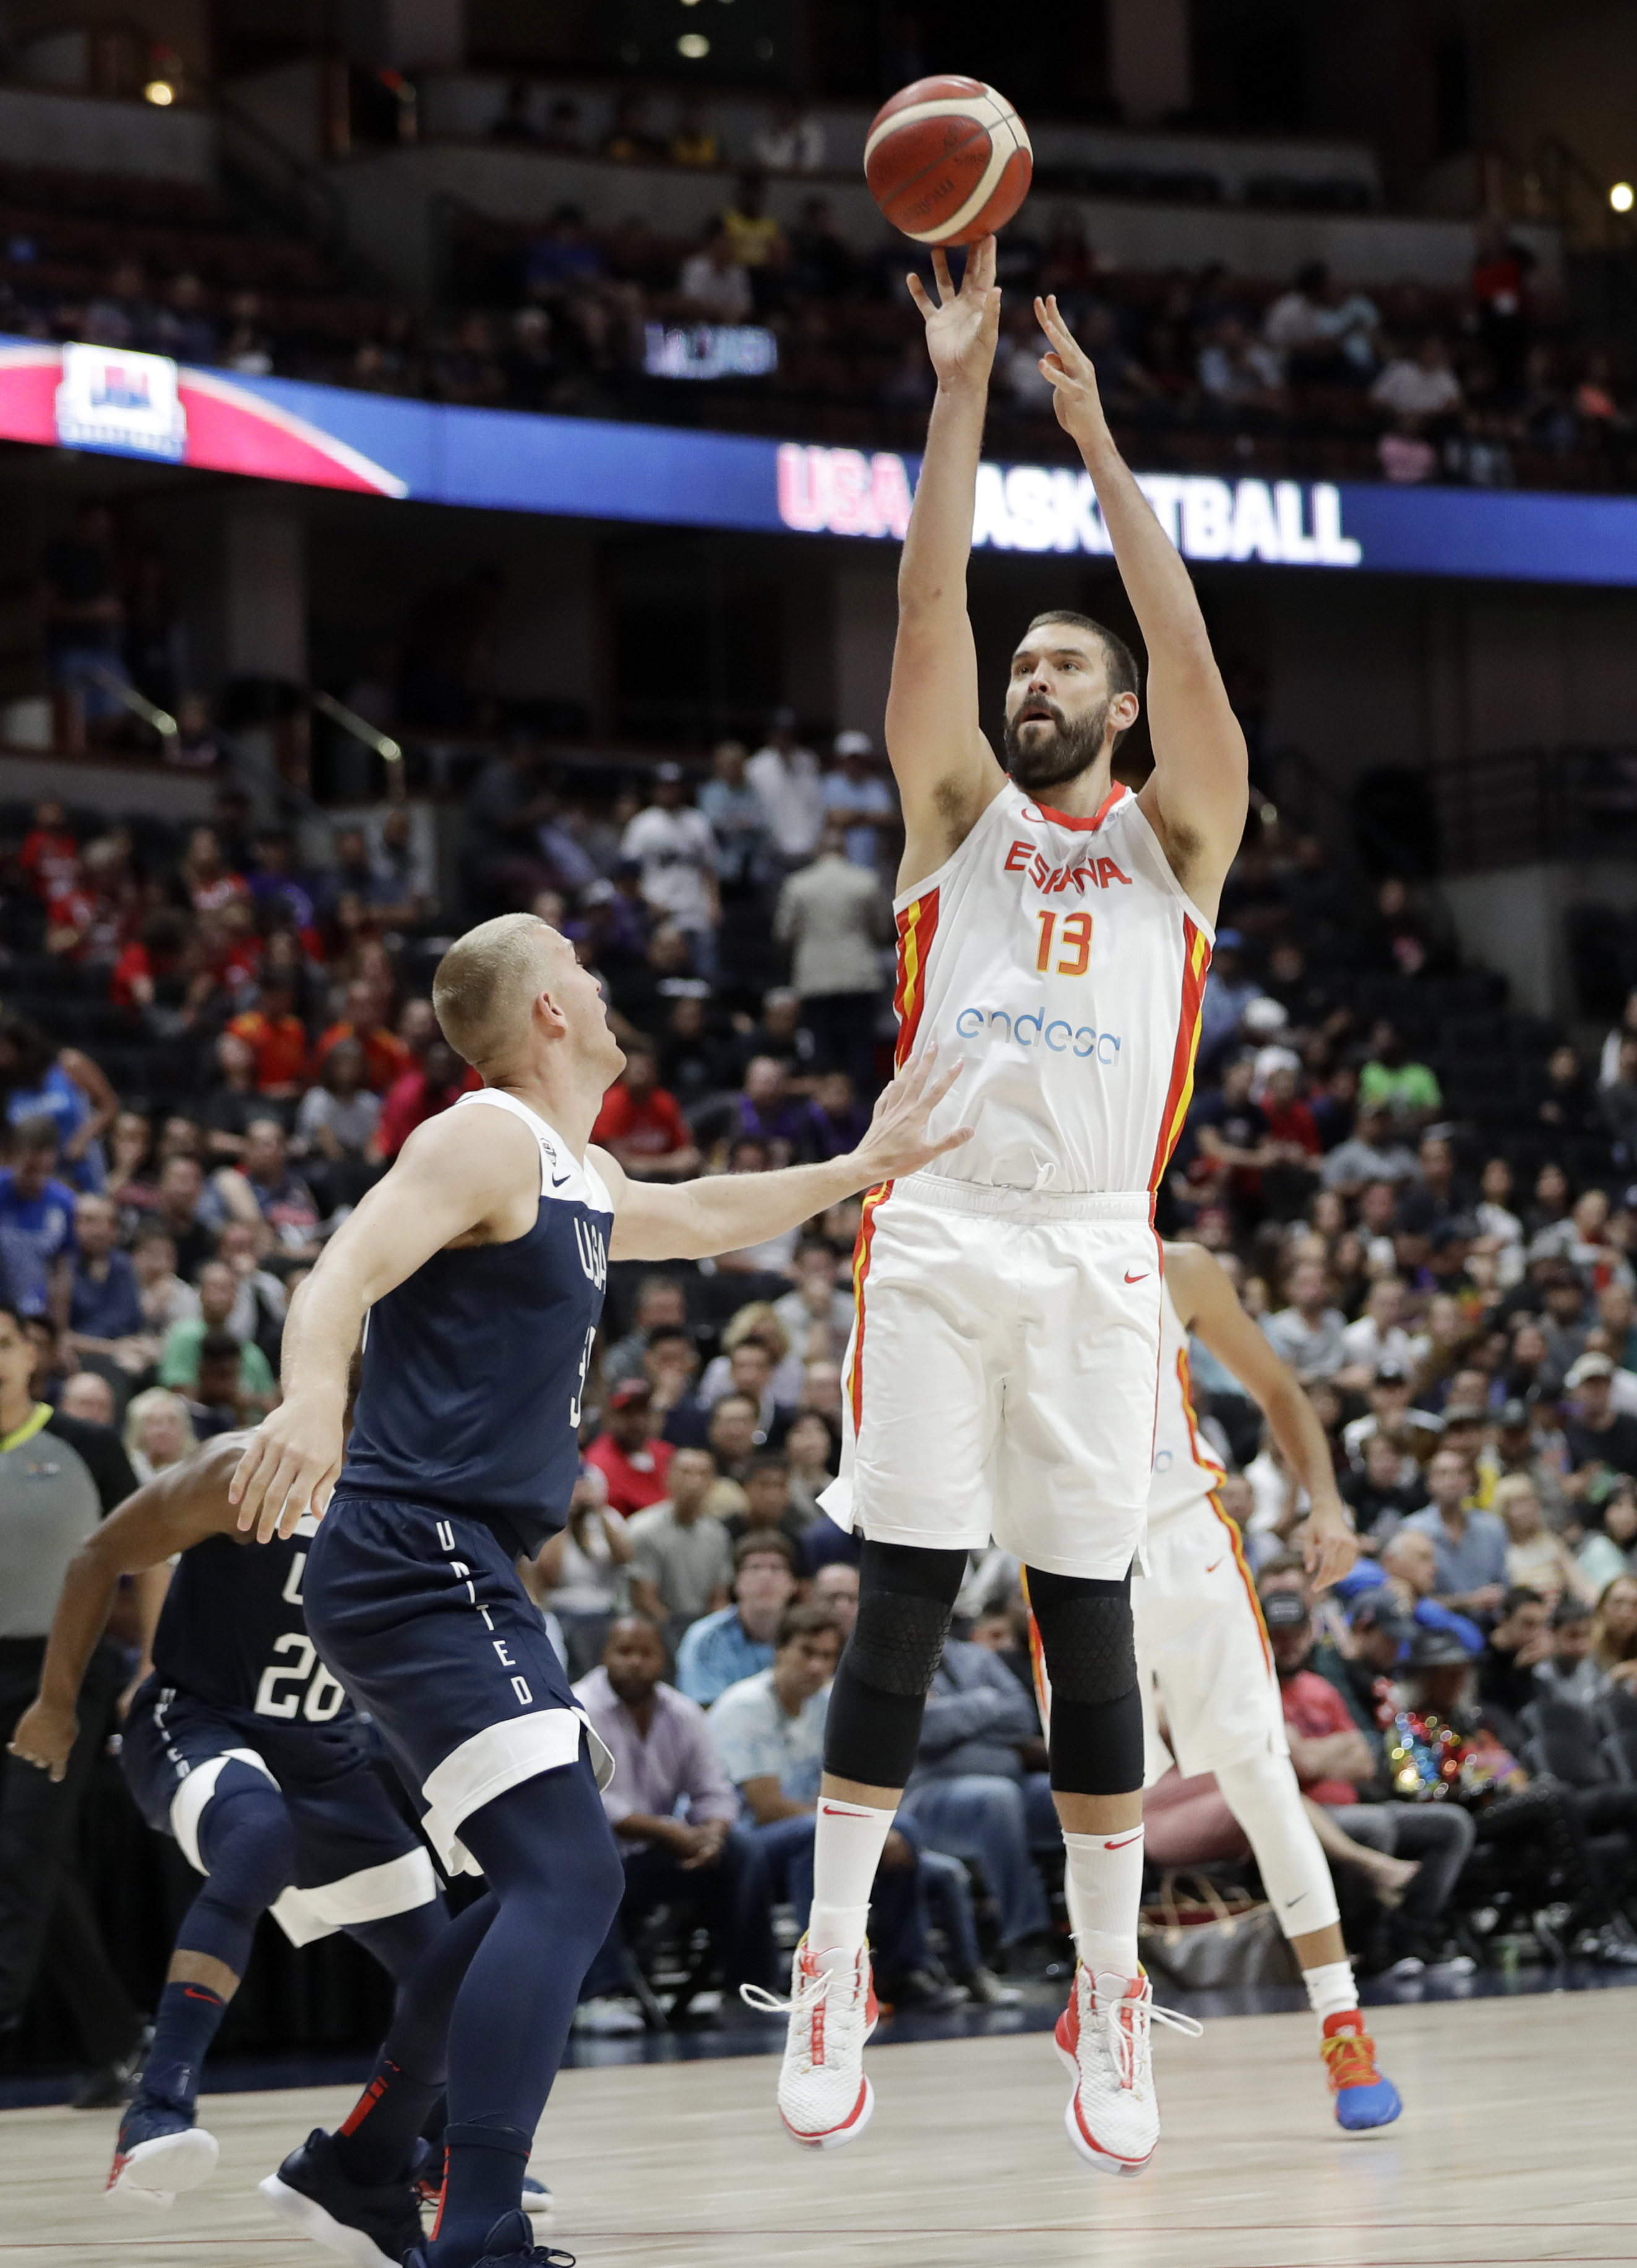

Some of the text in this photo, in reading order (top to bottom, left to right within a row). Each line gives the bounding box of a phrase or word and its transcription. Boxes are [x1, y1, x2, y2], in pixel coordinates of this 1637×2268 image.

[776, 442, 1362, 568] USA ASKTBALL
[1036, 909, 1094, 977] 13
[956, 1006, 1121, 1067] endesa
[573, 1216, 607, 1295] USA
[436, 1519, 533, 1706] UNITED
